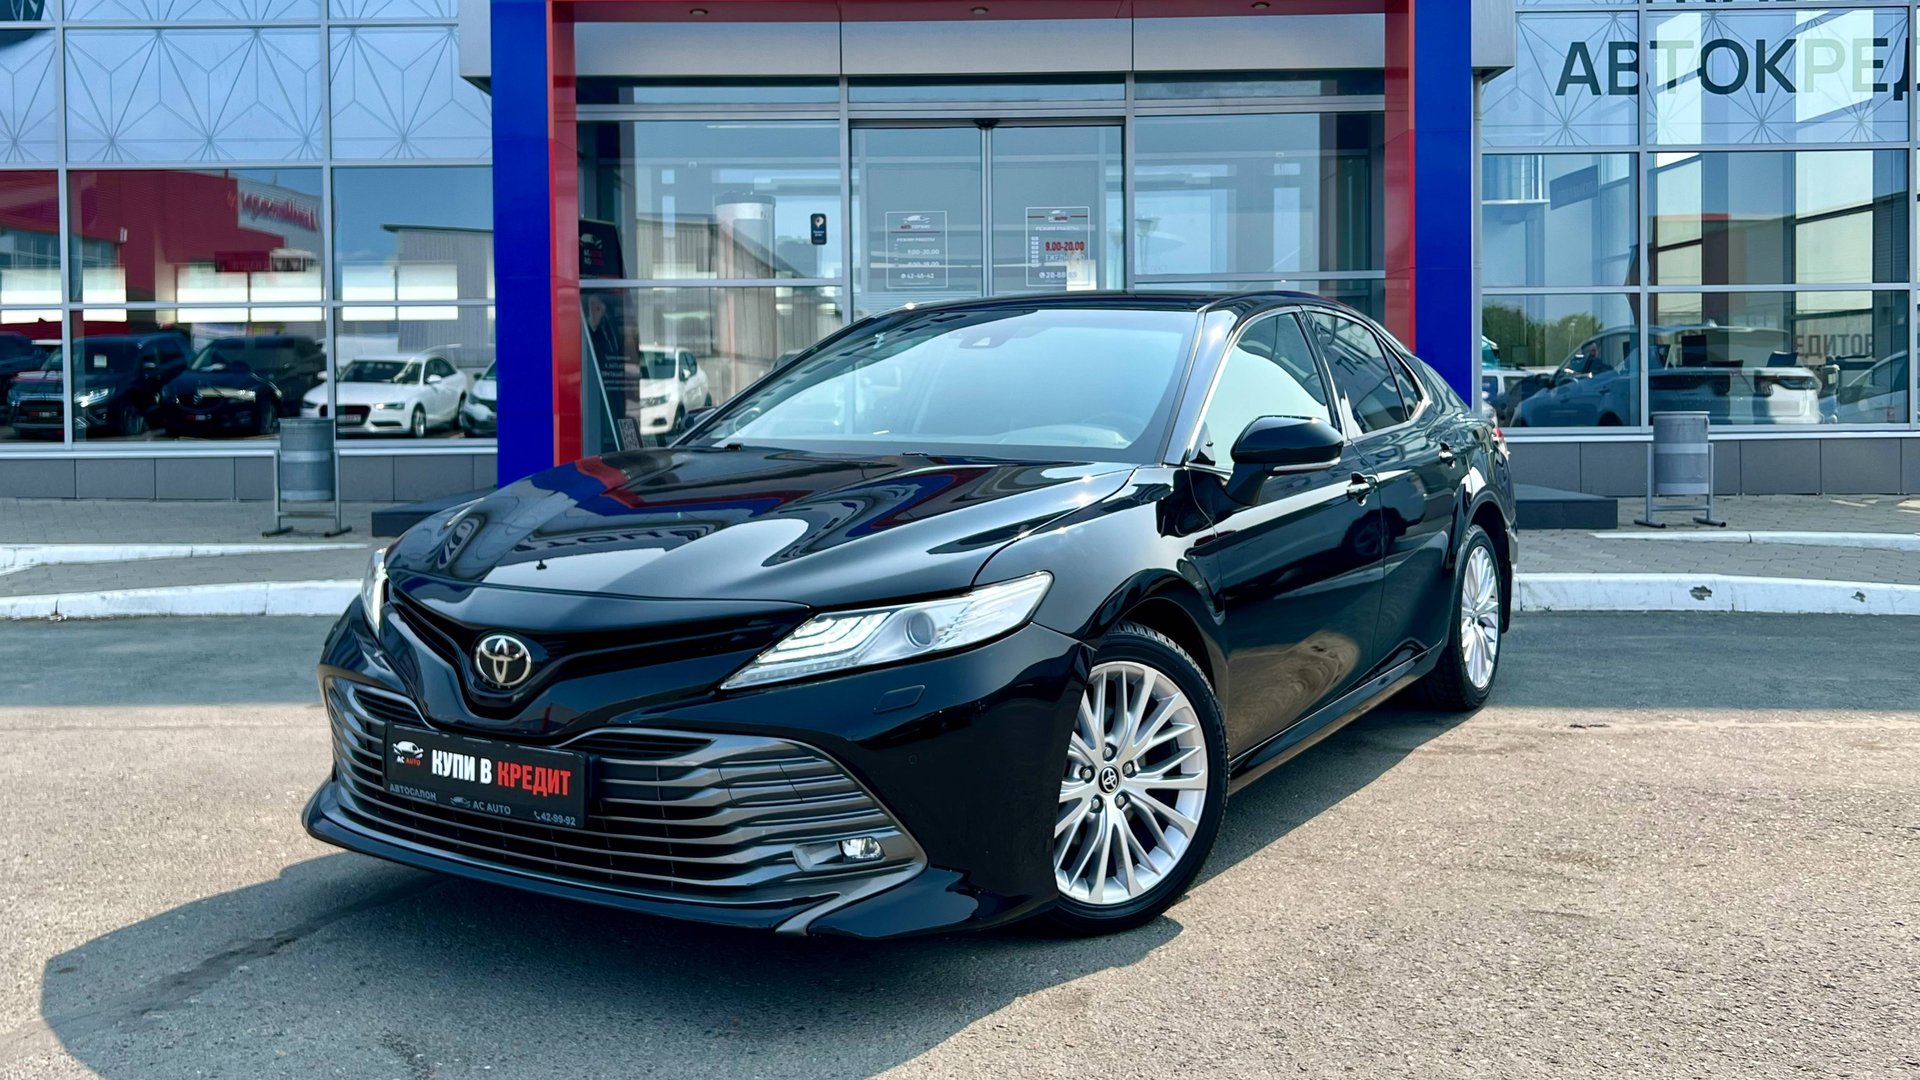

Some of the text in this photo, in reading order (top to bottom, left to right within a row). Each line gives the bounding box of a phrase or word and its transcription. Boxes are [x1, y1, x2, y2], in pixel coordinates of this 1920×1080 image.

[1045, 241, 1085, 251] 9.00-20.00
[405, 757, 421, 767] AUTO
[431, 749, 572, 797] КУПИ В КРЕДИТ
[389, 783, 437, 801] АВТОСАЛОН
[473, 800, 511, 815] AC AUTO
[540, 811, 576, 826] 42-99-92
